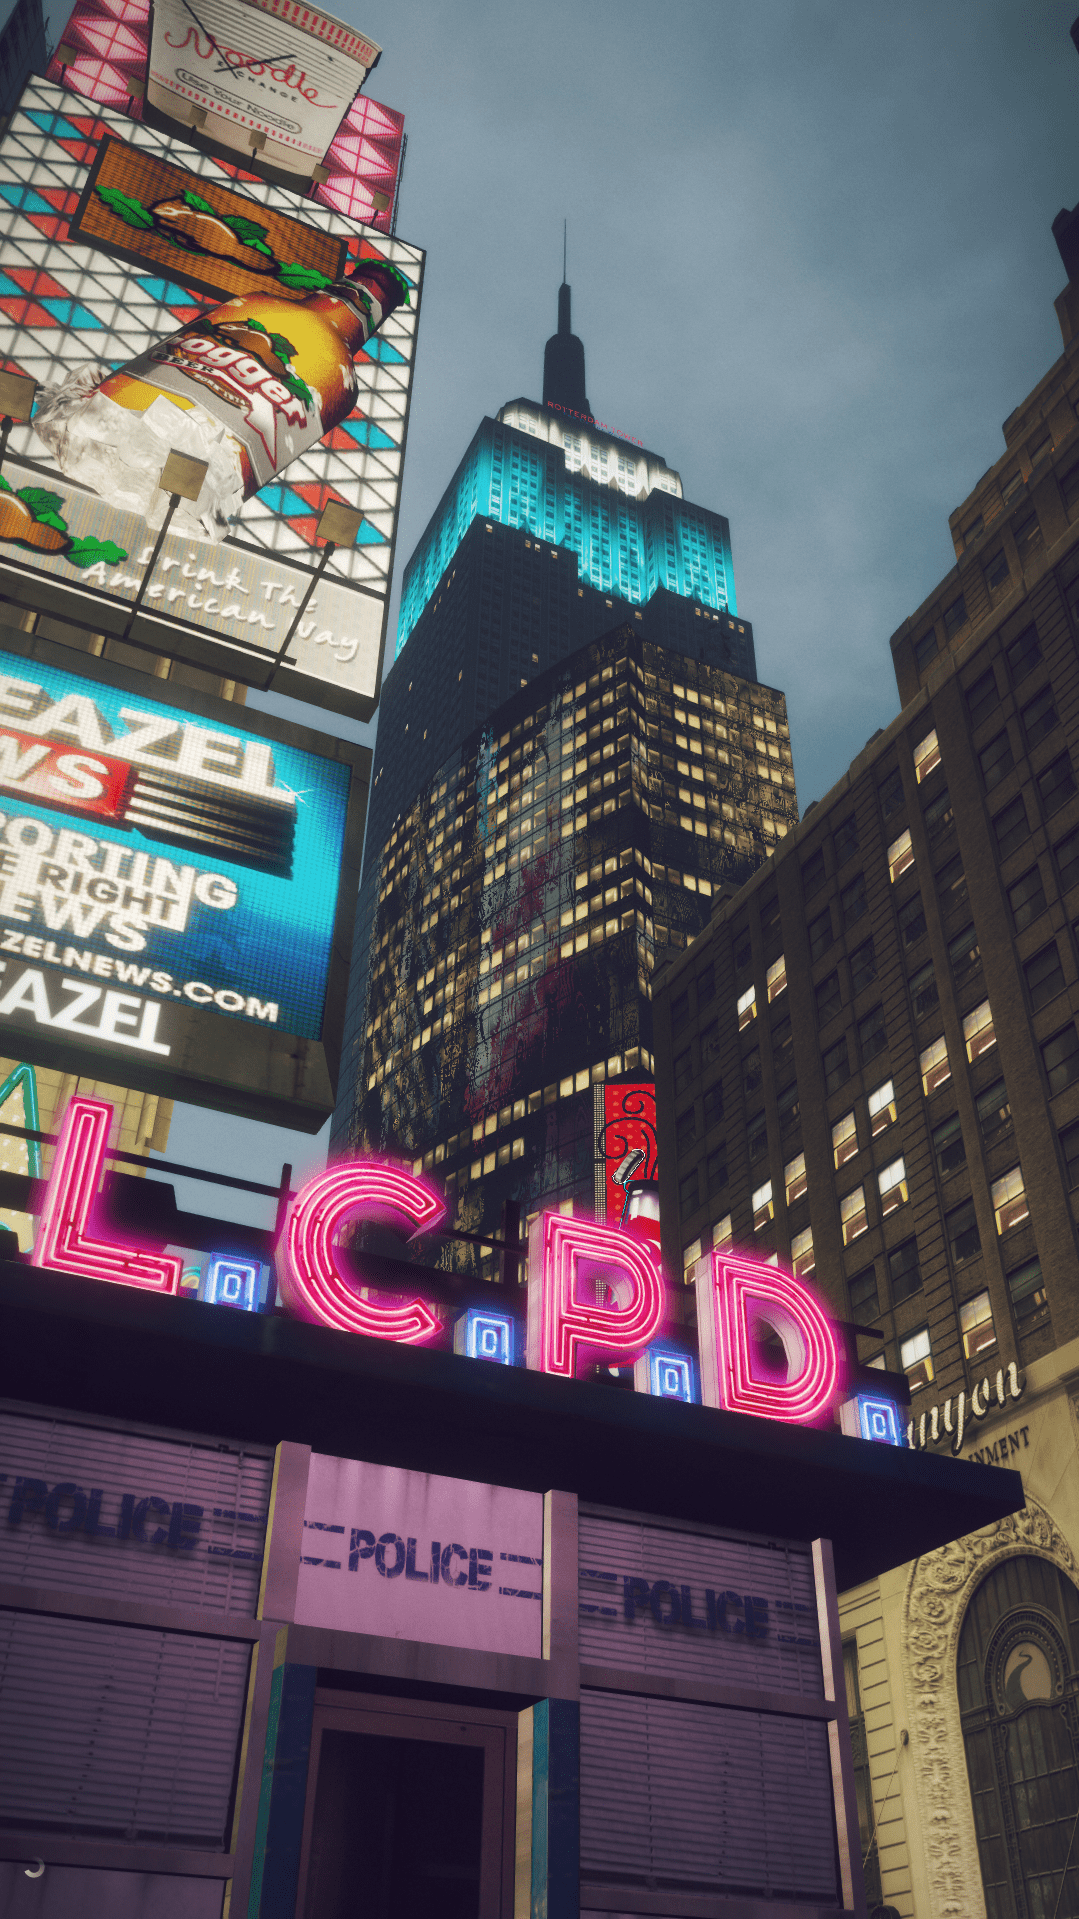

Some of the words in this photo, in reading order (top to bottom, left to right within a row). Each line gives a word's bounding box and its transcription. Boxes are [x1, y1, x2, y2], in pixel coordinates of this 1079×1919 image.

[165, 27, 338, 108] Noodle
[181, 71, 212, 91] Use
[213, 87, 243, 108] Your
[246, 103, 297, 131] Noodle
[547, 400, 608, 430] ROTTERDAM
[610, 426, 644, 448] TOWER
[81, 561, 277, 630] American
[260, 581, 318, 613] The
[0, 812, 239, 910] ORTING
[38, 861, 178, 926] RIGHT
[0, 961, 171, 1057] AZEL
[8, 1476, 204, 1551] POLICE
[348, 1527, 494, 1592] POLICE
[623, 1575, 769, 1639] POLICE
